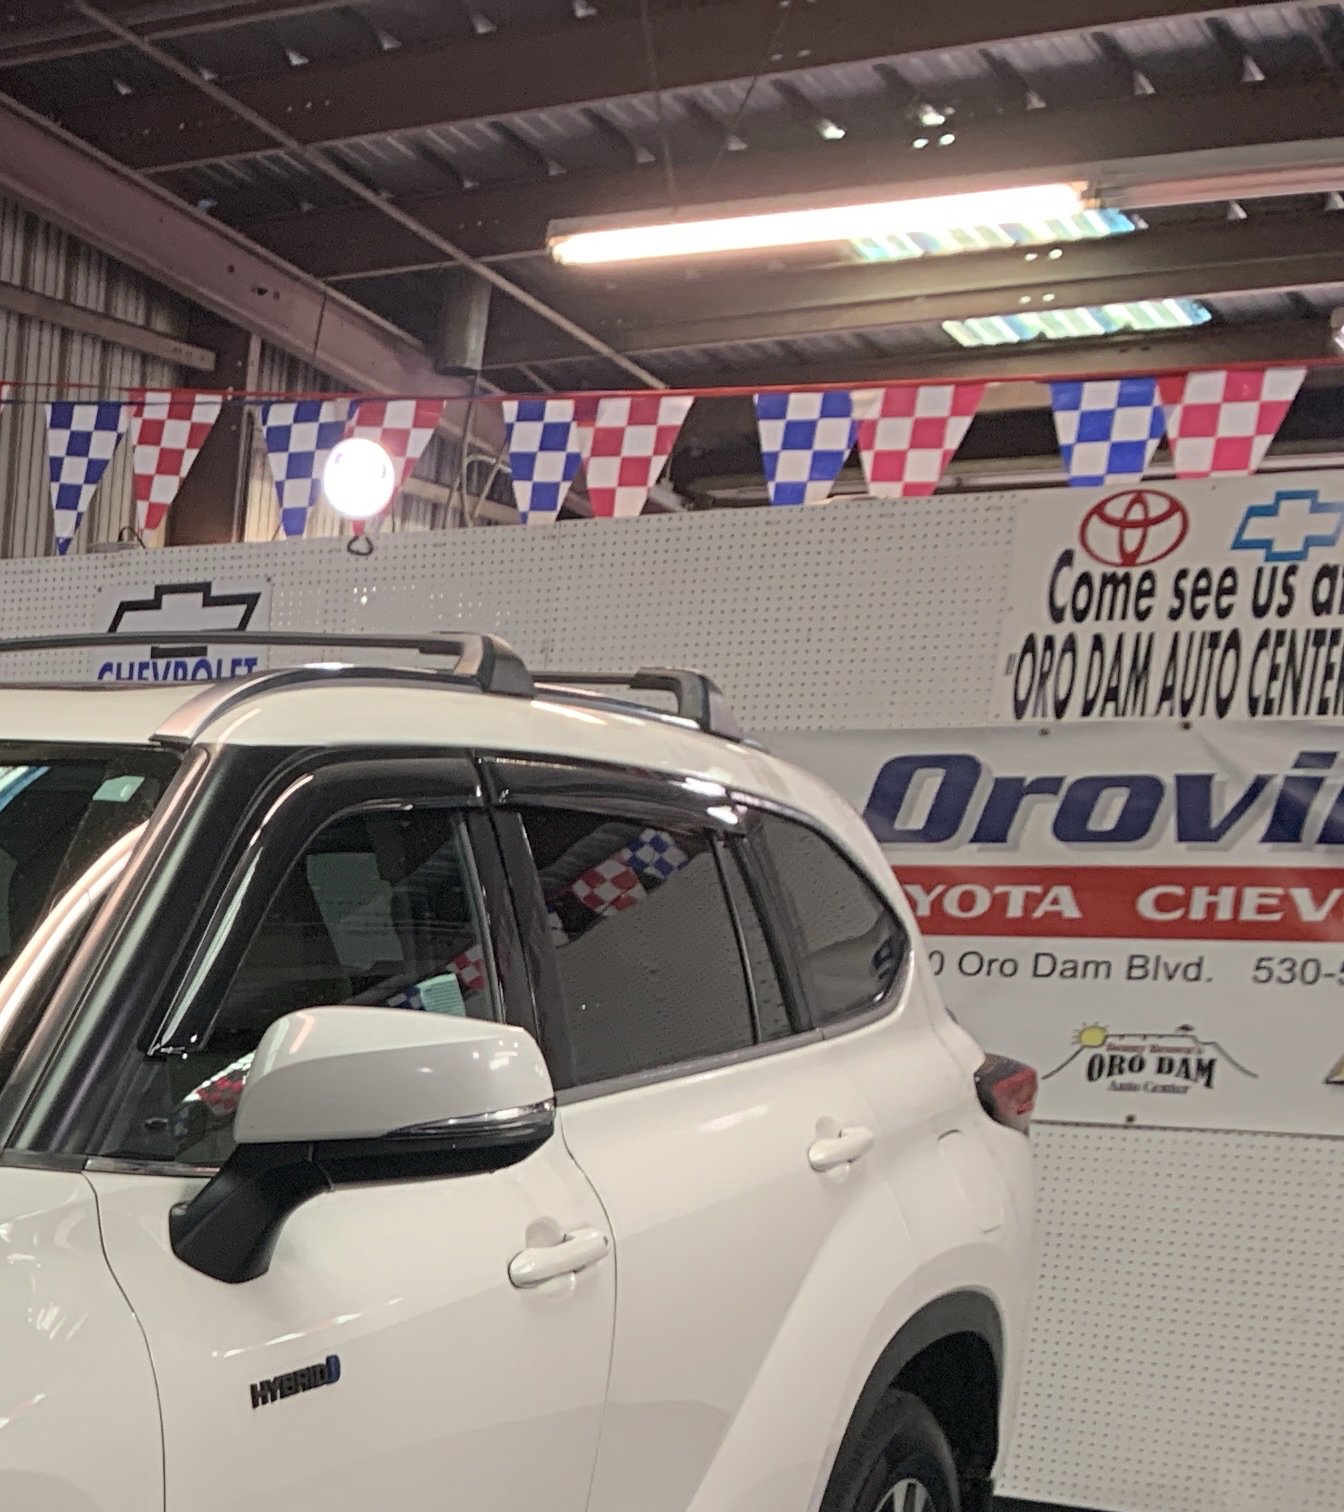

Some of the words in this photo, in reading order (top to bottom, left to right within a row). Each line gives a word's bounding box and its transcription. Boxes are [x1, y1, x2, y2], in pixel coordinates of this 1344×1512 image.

[1049, 548, 1156, 624] Come
[1168, 566, 1237, 622] see
[1252, 565, 1298, 619] us
[1312, 563, 1344, 616] a
[1082, 632, 1154, 718] DAM
[1158, 628, 1241, 719] AUTO
[1248, 628, 1344, 718] CENTE
[863, 752, 1344, 845] Orovi
[903, 884, 1083, 919] YOTA
[1136, 885, 1344, 922] CHEV
[959, 951, 1018, 977] Oro
[1032, 952, 1111, 979] Dam
[1126, 954, 1212, 982] Blvd.
[1253, 957, 1344, 985] 530-
[1087, 1053, 1146, 1082] ORO
[1156, 1056, 1217, 1089] DAM
[250, 1362, 329, 1409] HYBRID
